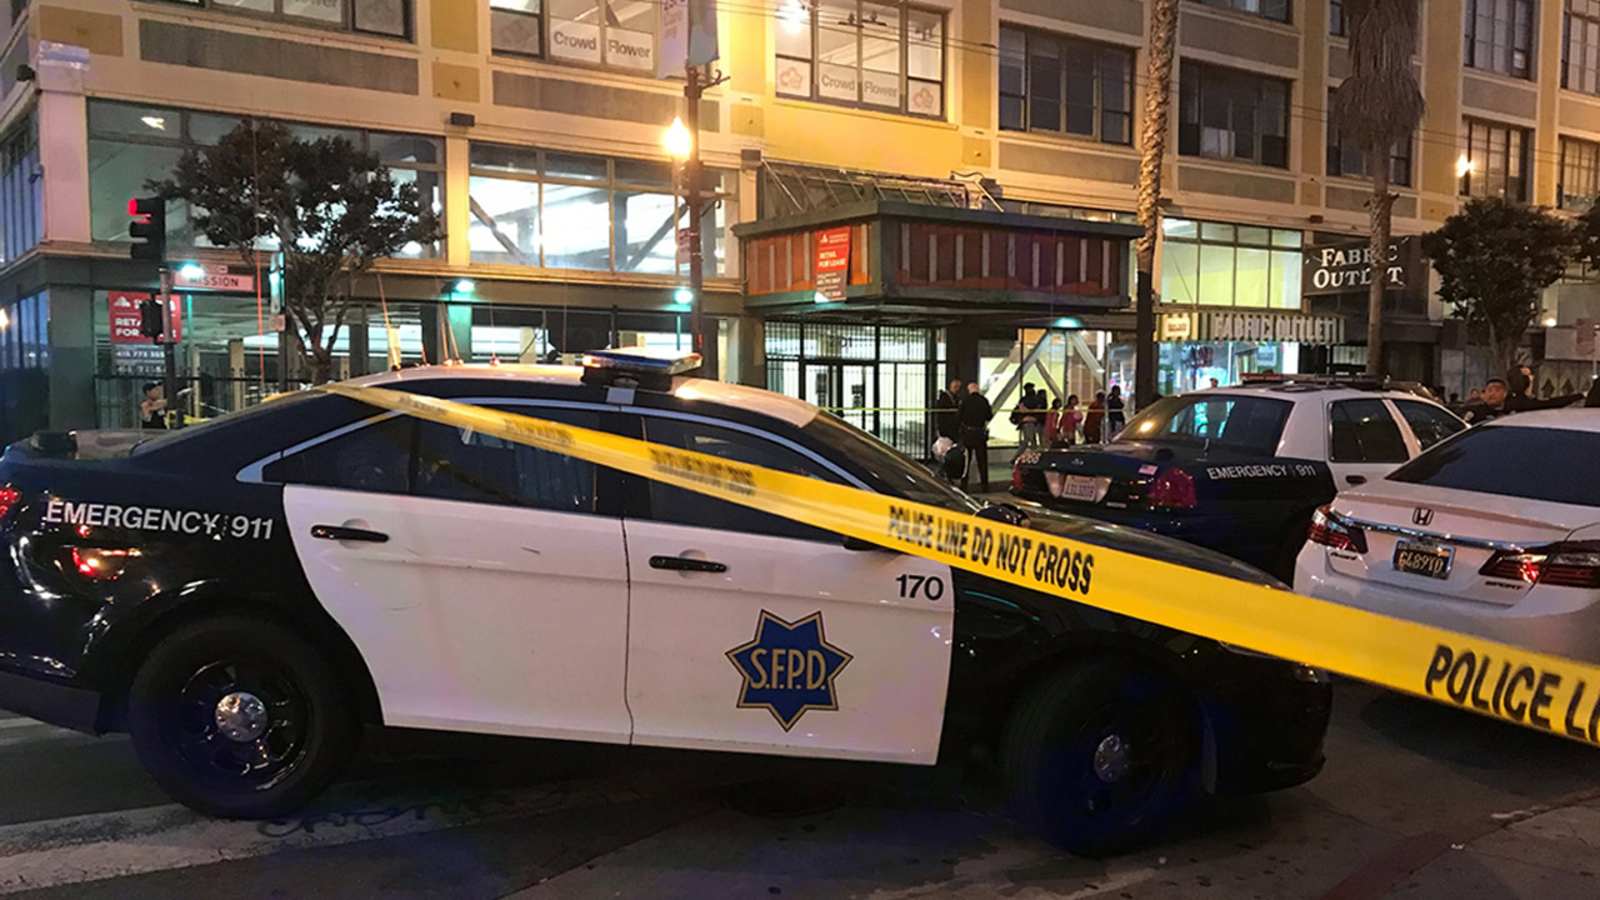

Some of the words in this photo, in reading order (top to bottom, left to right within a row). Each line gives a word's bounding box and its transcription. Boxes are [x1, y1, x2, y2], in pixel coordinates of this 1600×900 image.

[553, 31, 597, 51] Crowd
[608, 39, 651, 58] Flower
[821, 74, 856, 92] Crowd
[864, 80, 898, 98] Flower
[1320, 245, 1398, 267] FABRC
[1313, 267, 1403, 289] OUTLT
[1213, 314, 1272, 341] FABRIC
[1275, 316, 1338, 342] OUTLET
[1206, 464, 1288, 480] EMERGENCY
[1295, 464, 1317, 477] 911
[46, 500, 220, 535] EMERGENCY
[231, 515, 273, 540] 911
[888, 505, 933, 548] POLICE
[937, 517, 969, 559] LINE
[972, 526, 993, 566] DO
[996, 532, 1032, 576] NOT
[1033, 542, 1094, 595] CROSS
[895, 574, 944, 601] 170
[750, 649, 826, 690] S.F.P.D.
[1425, 644, 1561, 731] POLICE
